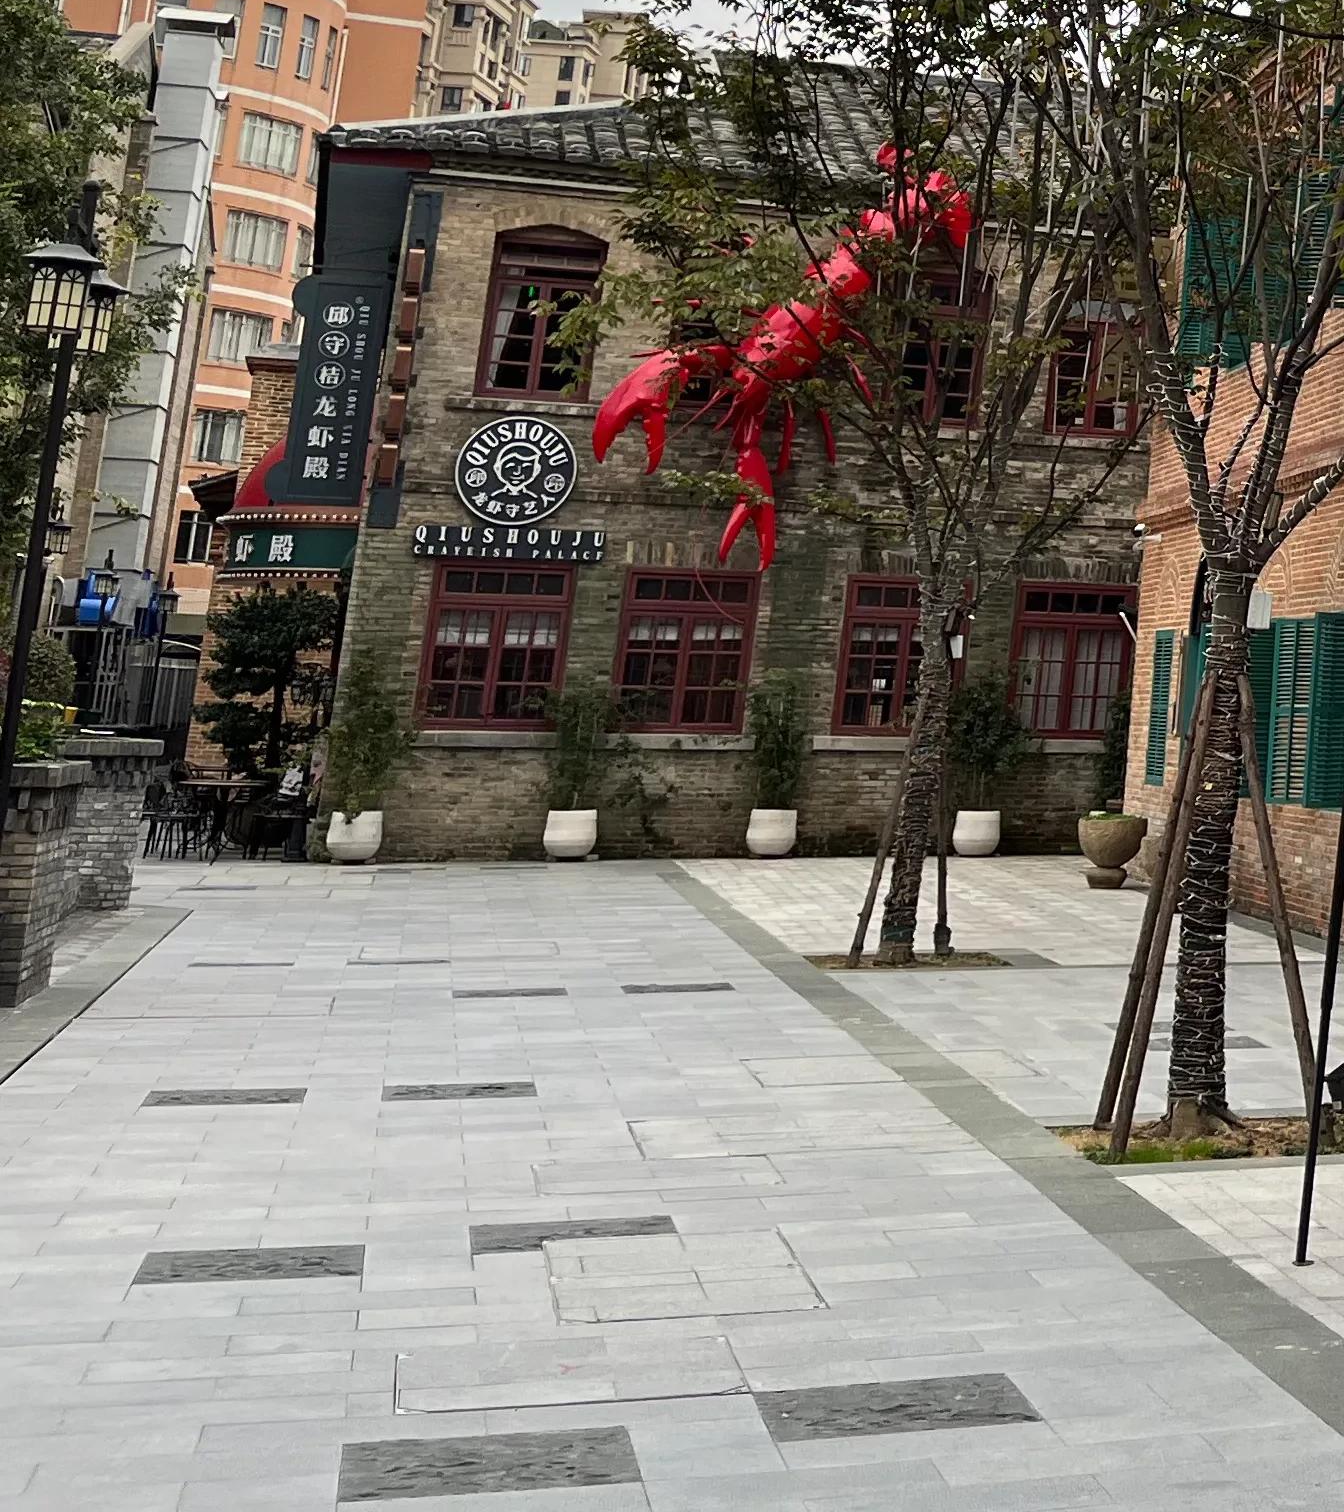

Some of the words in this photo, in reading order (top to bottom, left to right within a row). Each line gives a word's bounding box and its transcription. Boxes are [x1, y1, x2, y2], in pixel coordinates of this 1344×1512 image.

[344, 389, 358, 417] LONG
[465, 421, 569, 467] QIUSHOUJU
[415, 525, 605, 547] QIUSHOUJU
